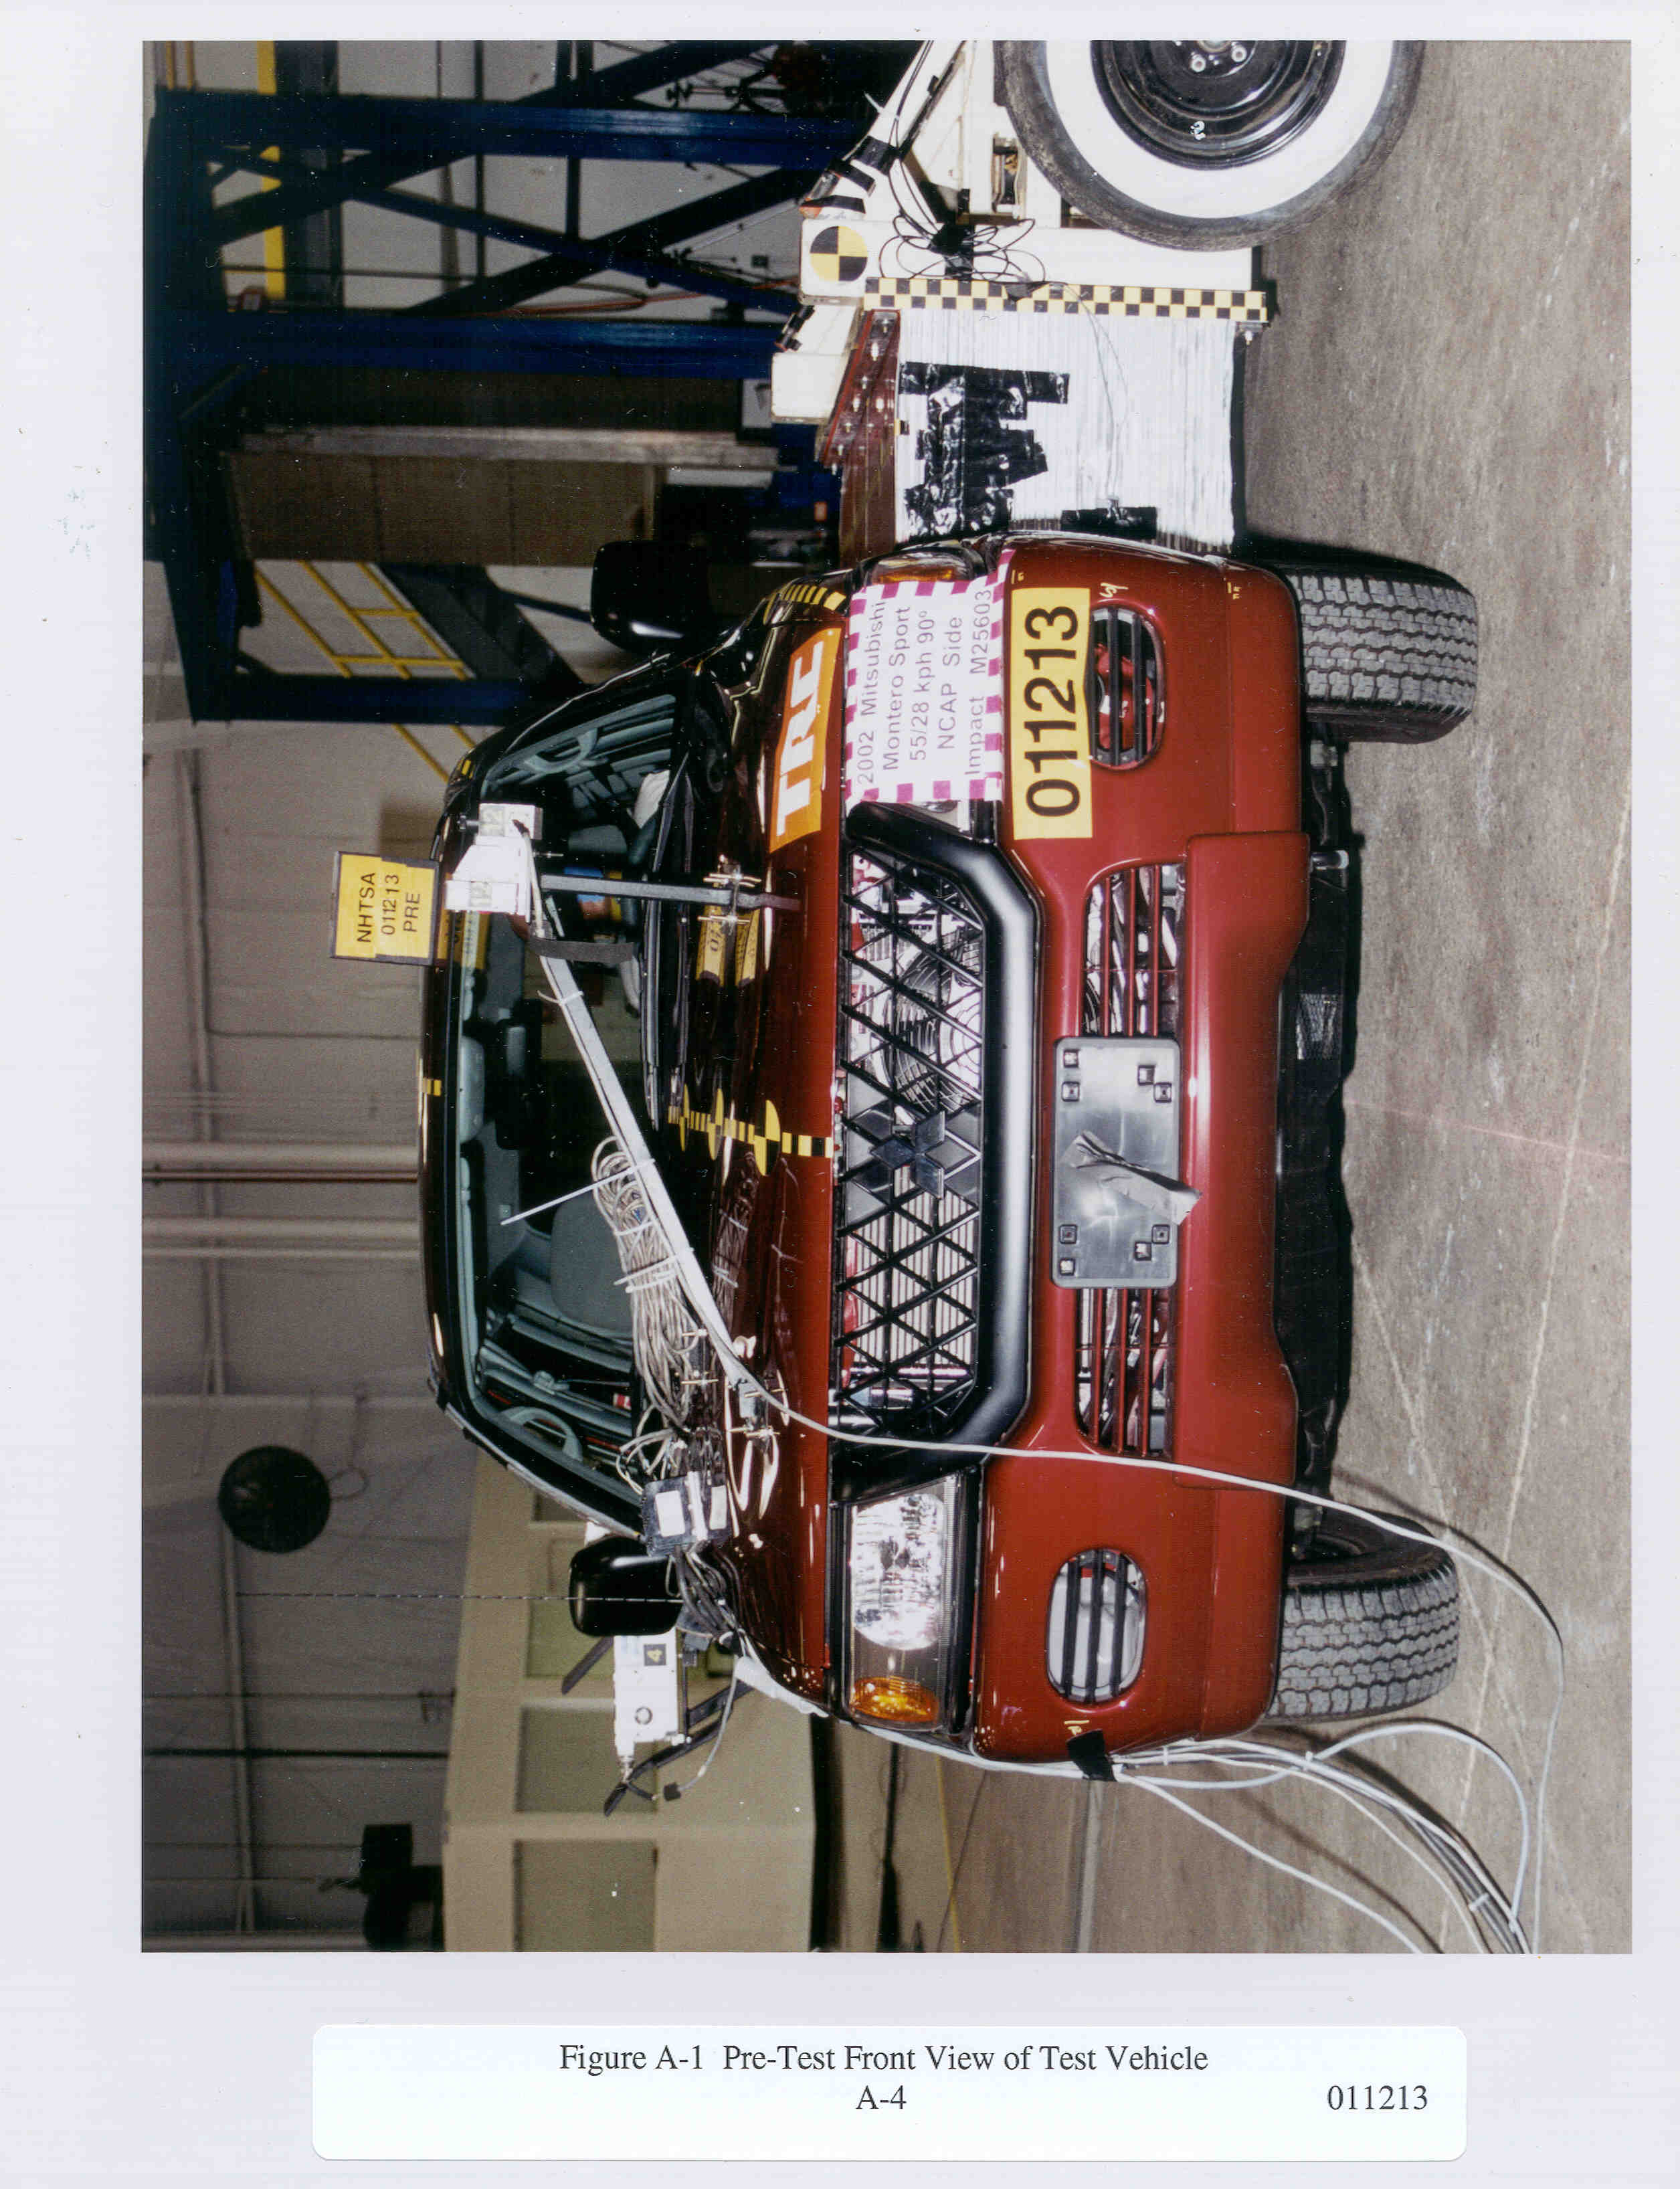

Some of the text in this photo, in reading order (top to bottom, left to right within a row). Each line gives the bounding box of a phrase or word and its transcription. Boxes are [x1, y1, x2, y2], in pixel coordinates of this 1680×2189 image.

[857, 601, 886, 784] 2002 Mitsubishi
[882, 605, 910, 770] Montero Sport
[913, 652, 935, 692] kph
[937, 616, 962, 749] NCAP Side
[964, 589, 992, 775] Impact M25603
[1024, 605, 1080, 817] 011213
[776, 640, 824, 836] TRC
[910, 701, 929, 761] 55/28
[357, 872, 375, 943] NHTSA
[381, 874, 399, 935] 011213
[403, 891, 420, 932] PRE
[647, 1648, 663, 1662] 4
